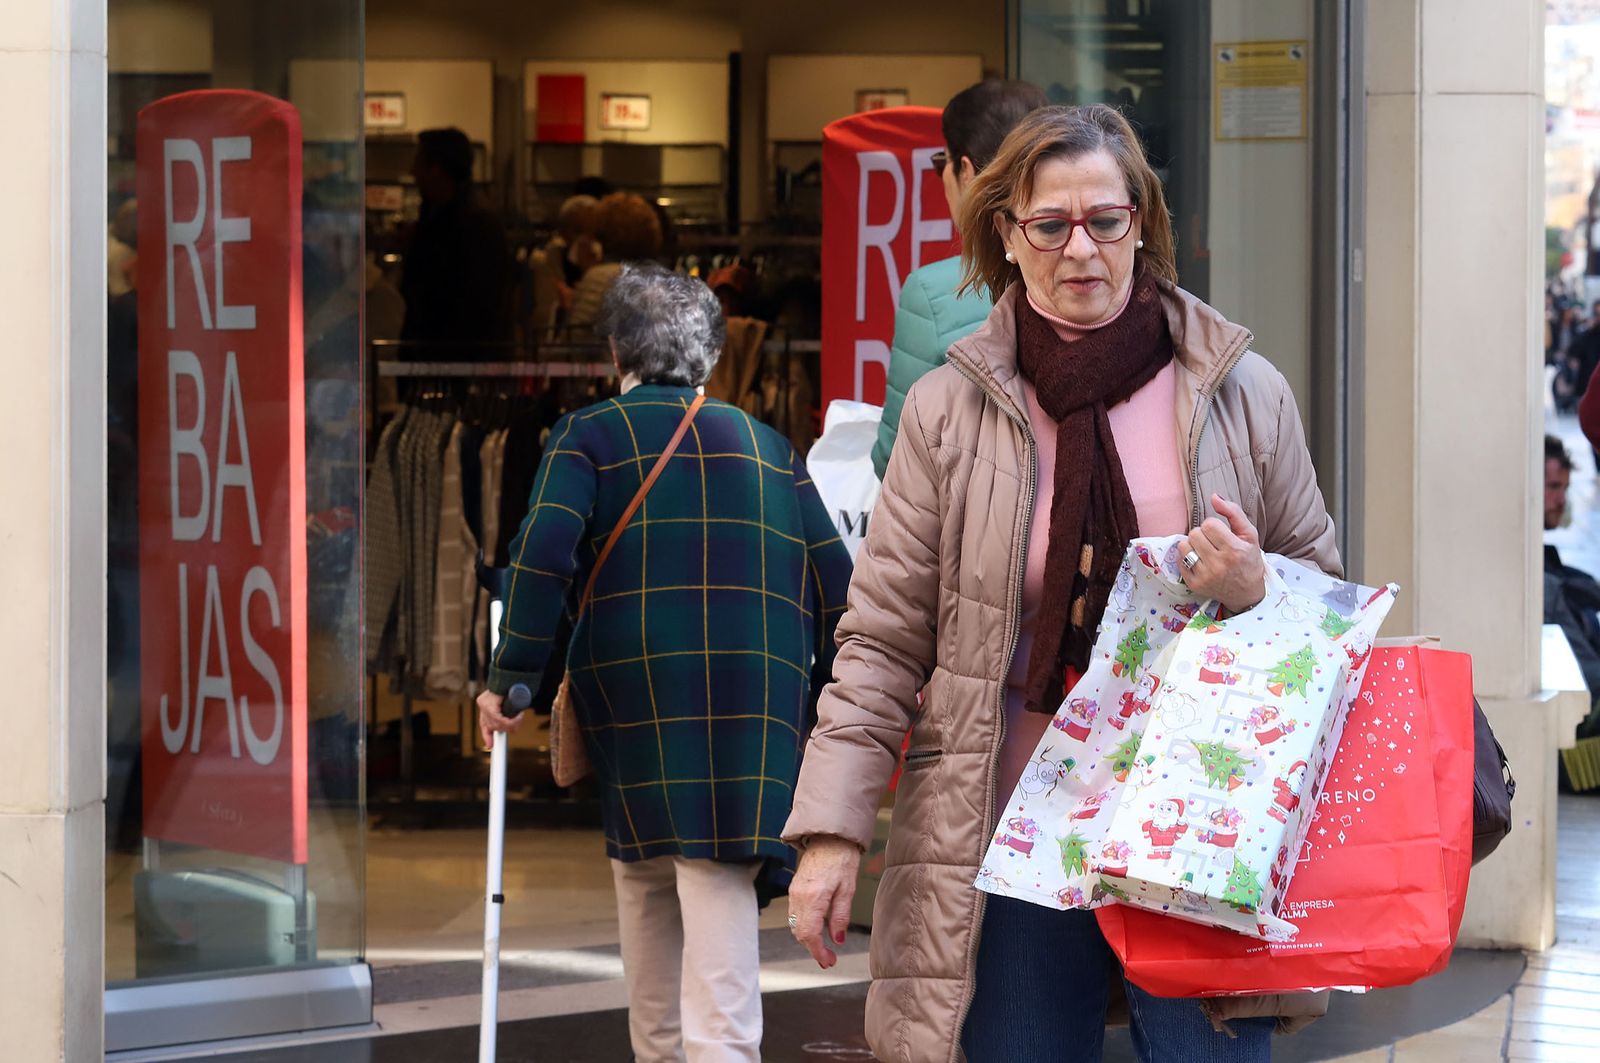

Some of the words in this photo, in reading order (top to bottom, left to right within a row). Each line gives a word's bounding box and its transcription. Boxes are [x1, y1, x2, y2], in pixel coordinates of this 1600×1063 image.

[164, 136, 256, 330] RE
[855, 146, 953, 322] RE
[168, 350, 262, 546] BA
[160, 563, 284, 765] JAS
[1321, 788, 1376, 805] RENO
[1289, 900, 1335, 910] EMPRESA
